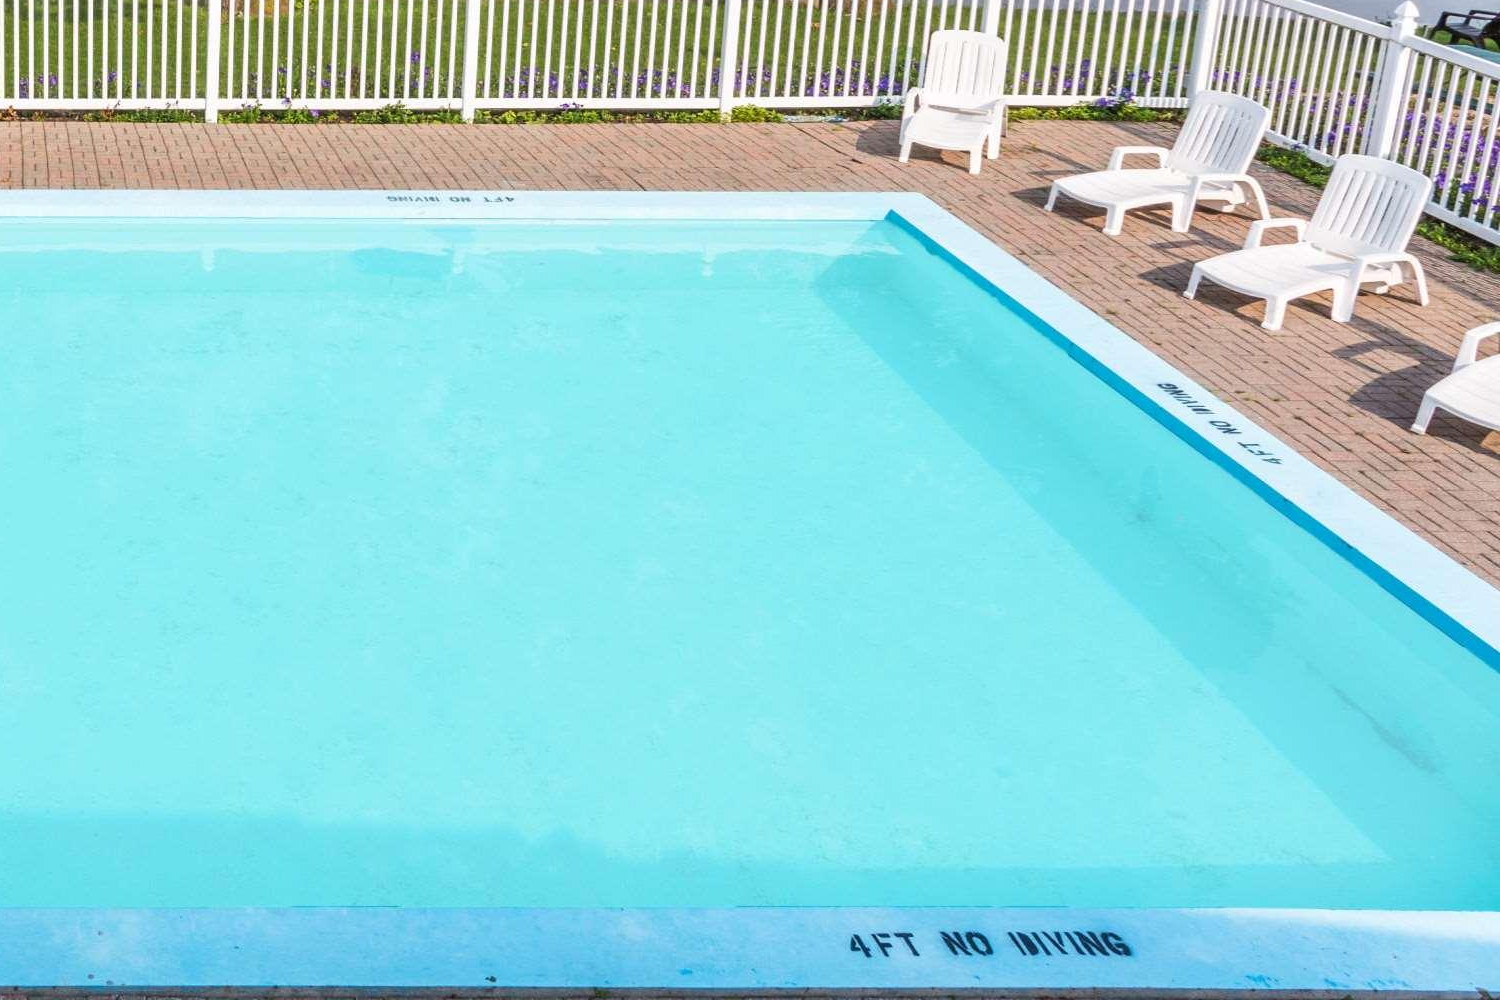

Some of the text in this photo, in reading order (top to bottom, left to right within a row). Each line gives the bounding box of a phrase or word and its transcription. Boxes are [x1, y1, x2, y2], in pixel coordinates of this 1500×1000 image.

[386, 195, 441, 203] DIVING
[449, 195, 472, 203] NO
[1157, 383, 1283, 465] 4FT NO DIVING
[849, 931, 1133, 958] 4FT NO DIVING
